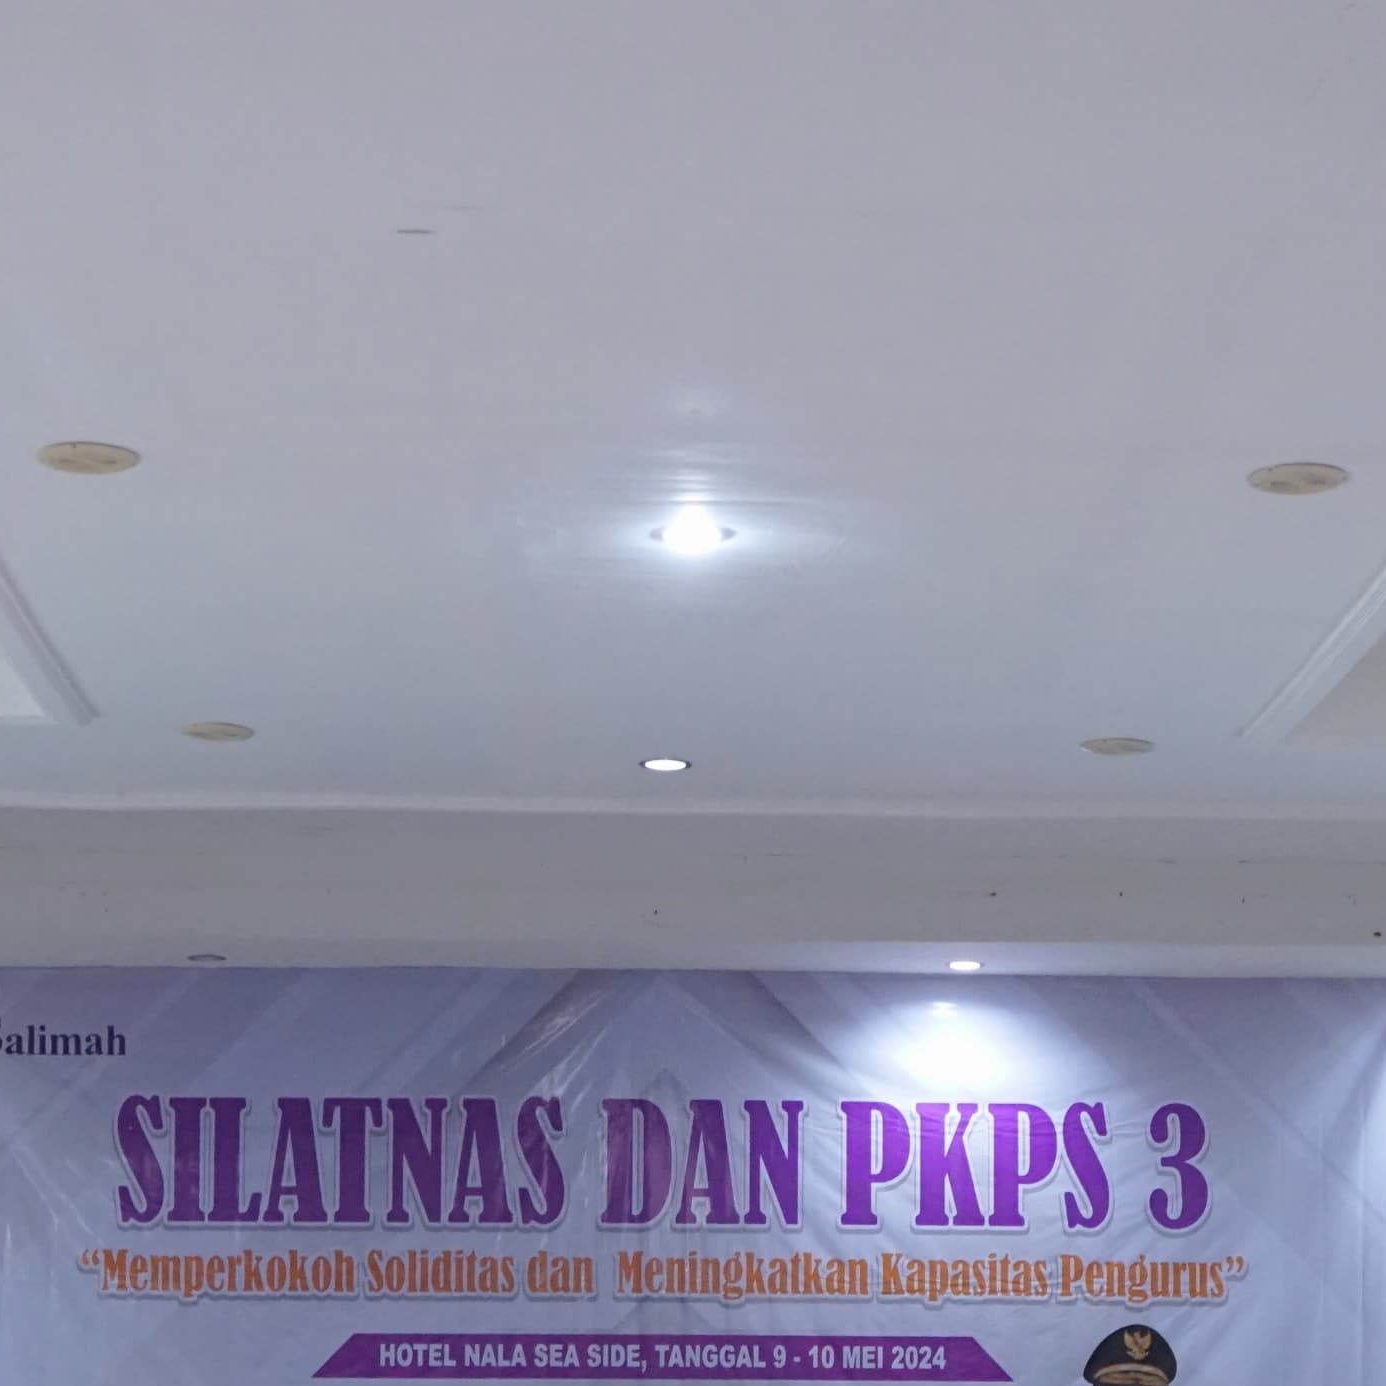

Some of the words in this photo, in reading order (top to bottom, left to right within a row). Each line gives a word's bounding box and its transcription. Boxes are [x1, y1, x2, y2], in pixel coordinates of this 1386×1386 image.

[115, 1095, 566, 1225] SILATNAS
[600, 1097, 805, 1227] DAN
[840, 1099, 1109, 1229] PKPS
[1148, 1102, 1208, 1231] 3
[367, 1249, 515, 1294] Soliditas
[527, 1249, 594, 1294] dan
[617, 1250, 869, 1299] Meningkatkan
[880, 1251, 1049, 1302] Kapasitas
[379, 1343, 455, 1368] HOTEL
[463, 1343, 529, 1368] NALA
[534, 1343, 580, 1368] SEA
[586, 1343, 648, 1374] SIDE,
[655, 1343, 767, 1370] TANGGAL
[773, 1343, 787, 1370] 9
[809, 1343, 835, 1370] 10
[842, 1344, 884, 1370] MEI
[890, 1344, 947, 1370] 2024
